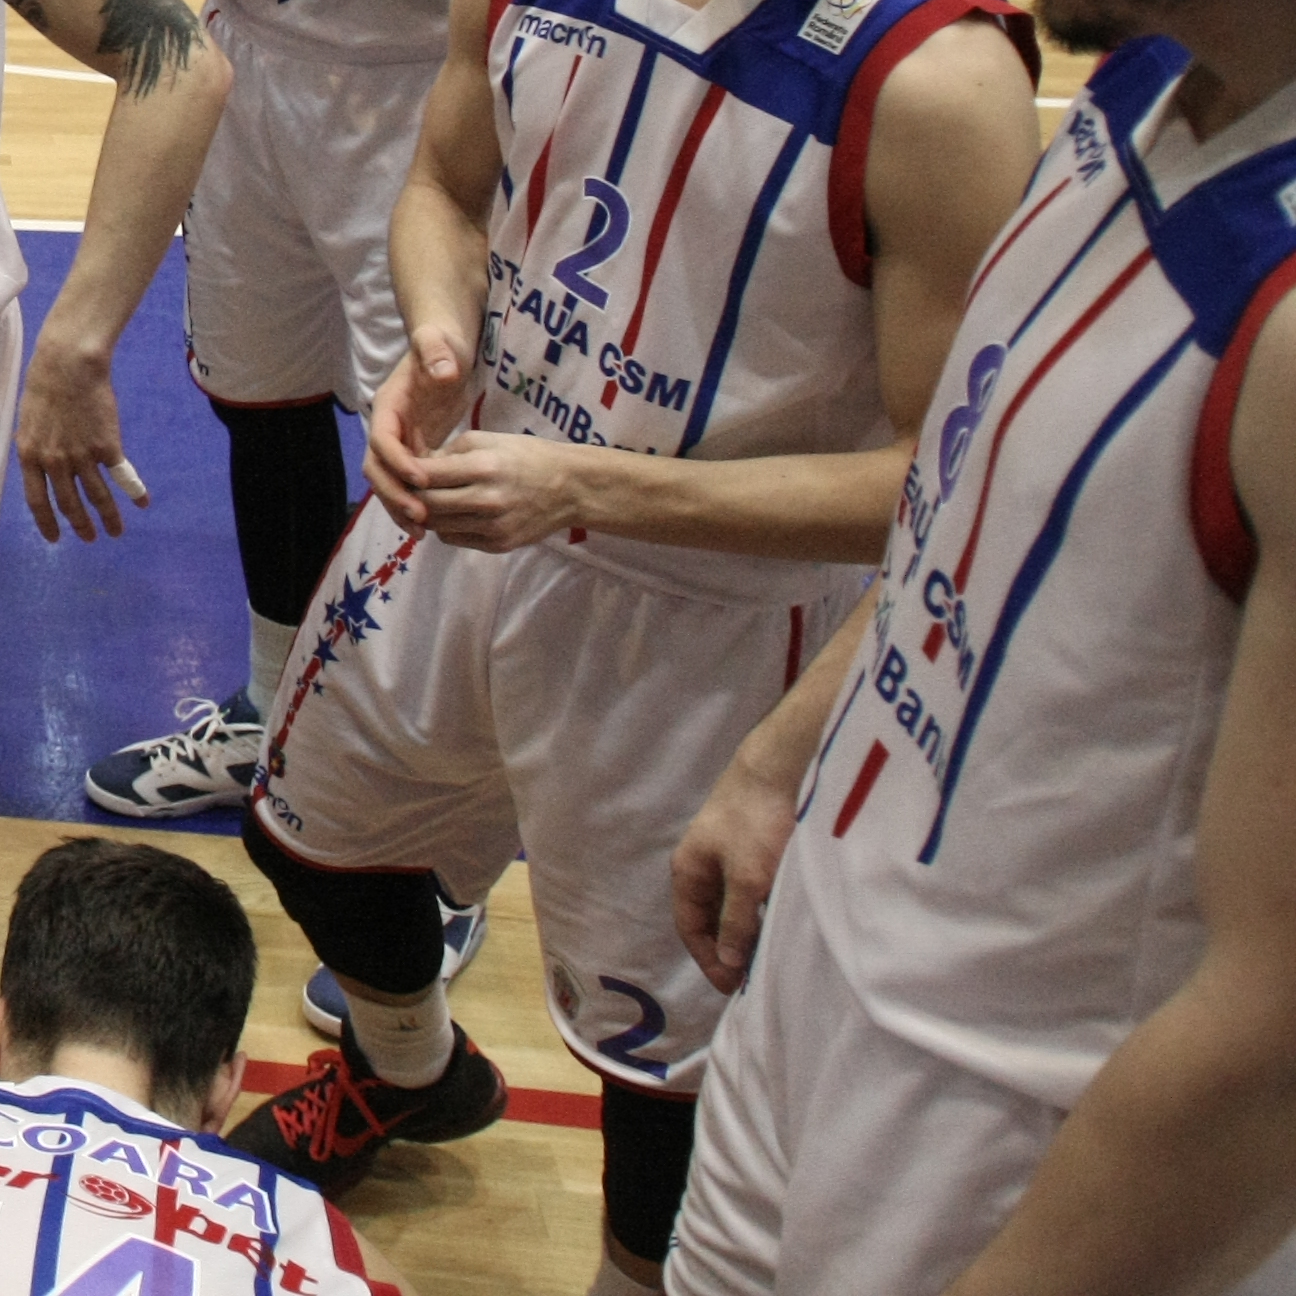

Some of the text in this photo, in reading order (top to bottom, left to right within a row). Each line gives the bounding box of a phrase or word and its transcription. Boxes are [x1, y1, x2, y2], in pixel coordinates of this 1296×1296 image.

[551, 175, 631, 311] 2
[599, 341, 692, 412] CSM
[596, 975, 669, 1081] 2
